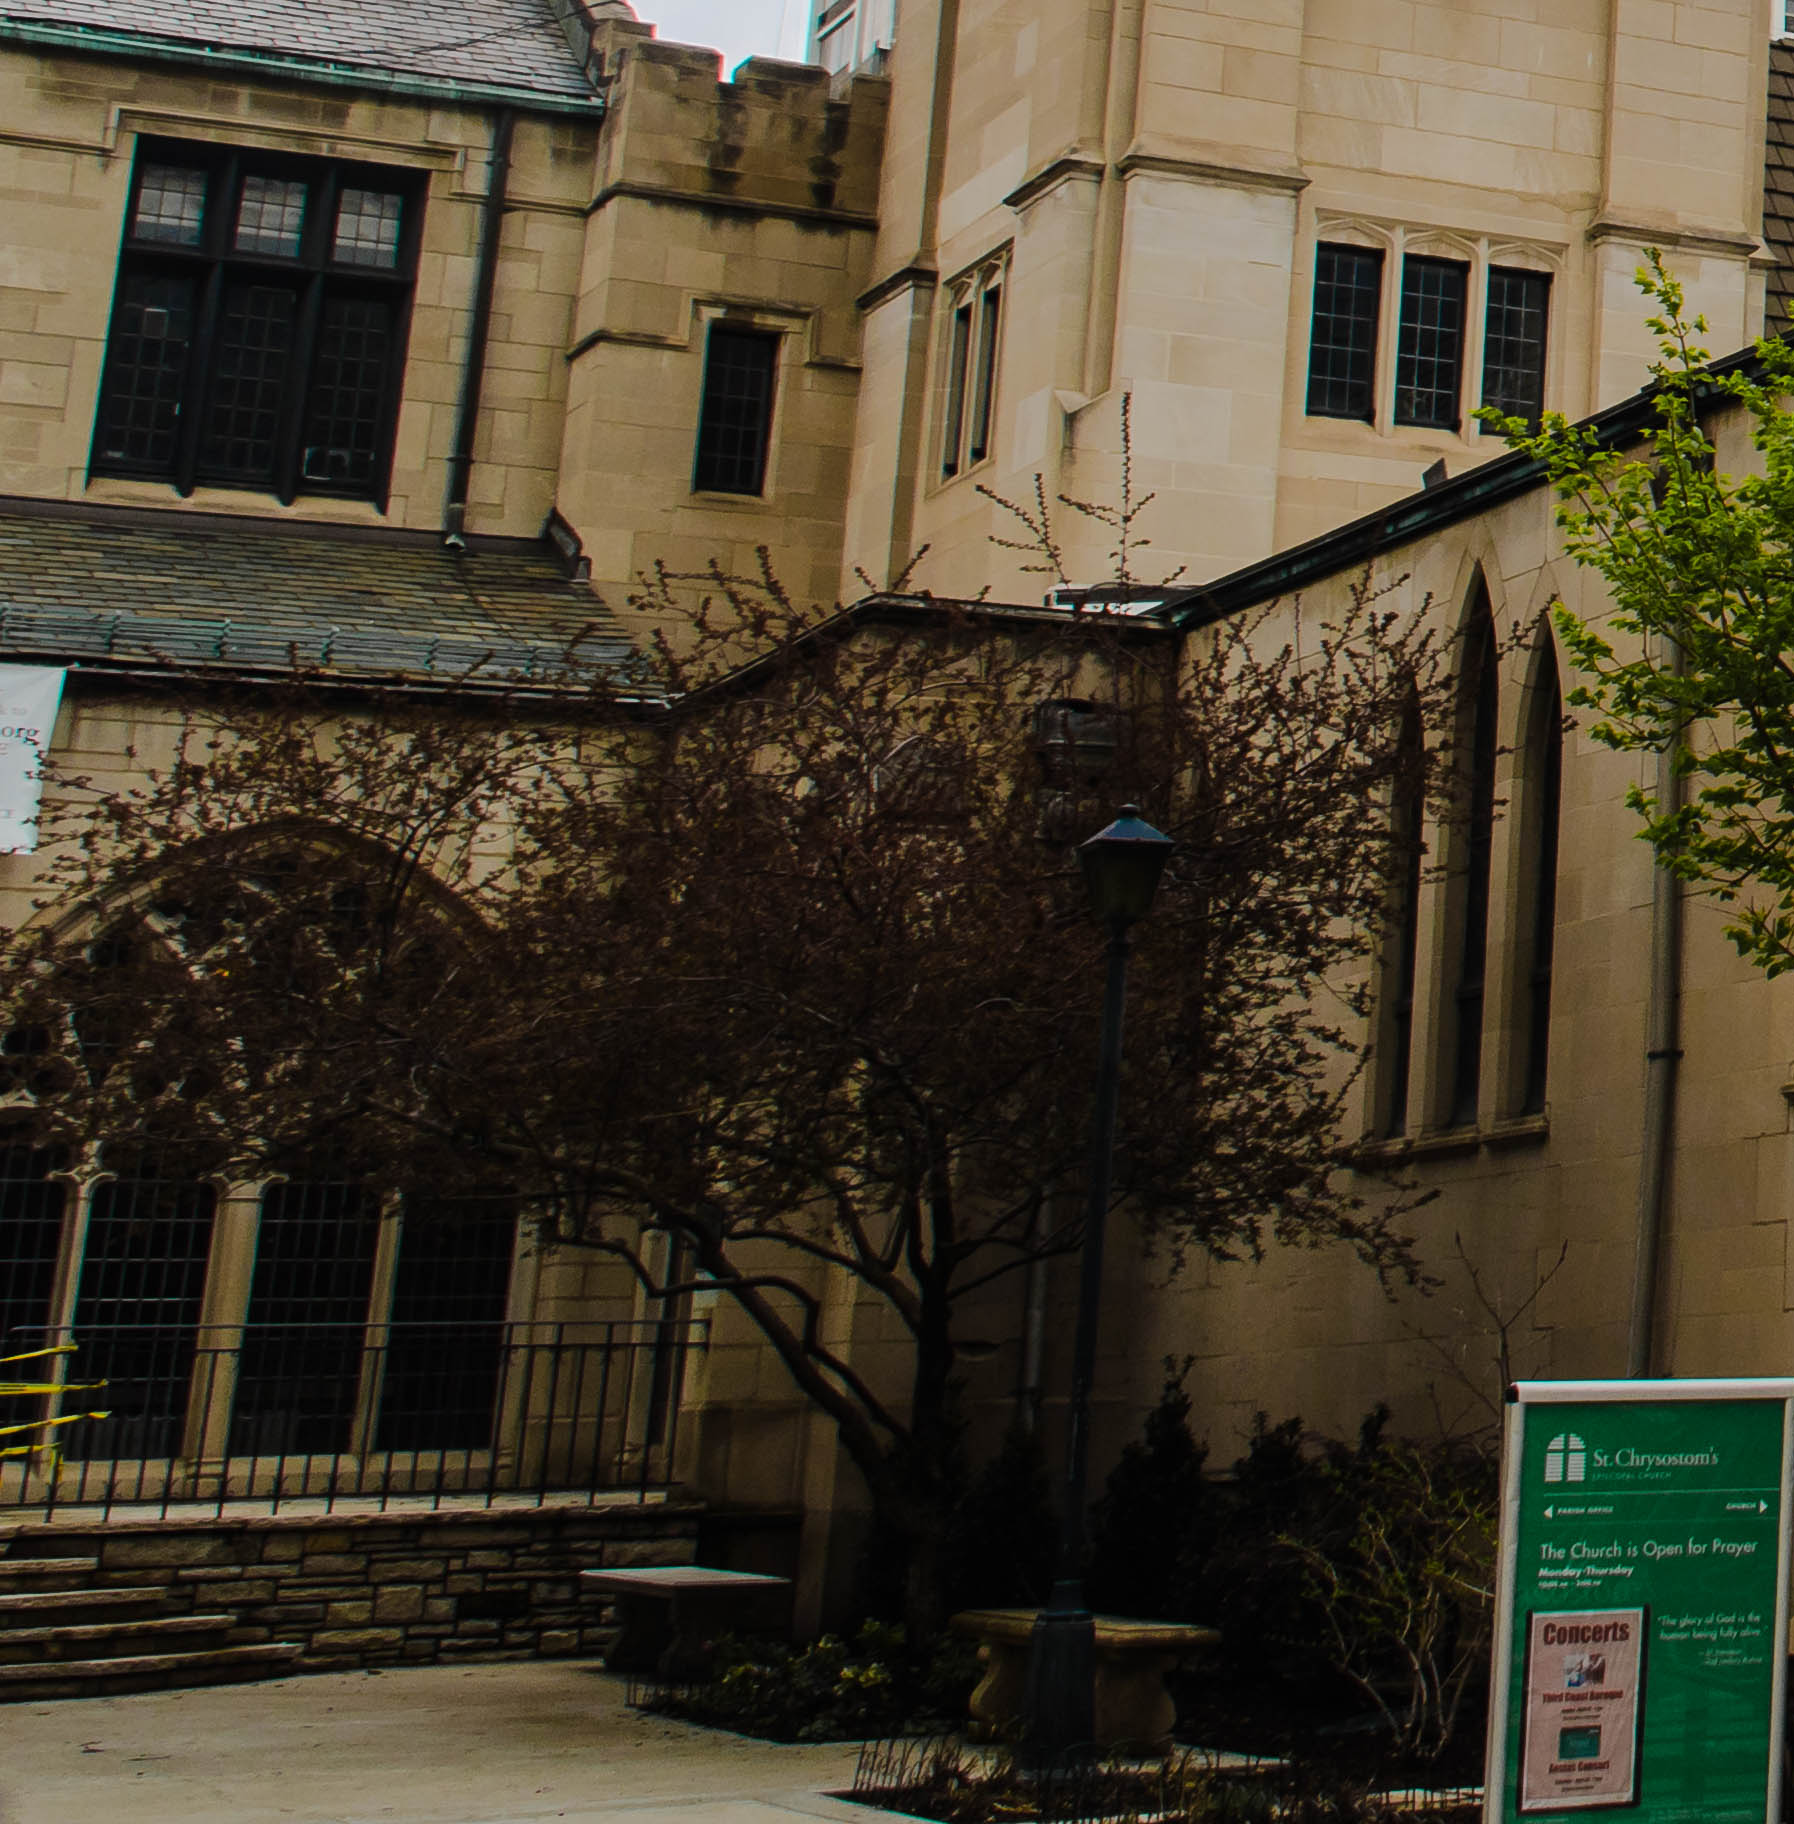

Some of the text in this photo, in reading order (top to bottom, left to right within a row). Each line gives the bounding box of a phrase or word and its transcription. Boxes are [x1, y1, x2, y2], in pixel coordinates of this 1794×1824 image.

[1592, 1446, 1720, 1472] St. Chrysostom's
[1540, 1536, 1759, 1560] The Church is Open for Prayer
[1679, 1613, 1703, 1629] glory
[1703, 1612, 1715, 1624] of
[1716, 1612, 1737, 1624] God
[1748, 1609, 1761, 1623] the
[1543, 1621, 1631, 1646] Concerts
[1692, 1627, 1718, 1642] being
[1719, 1625, 1738, 1640] fully
